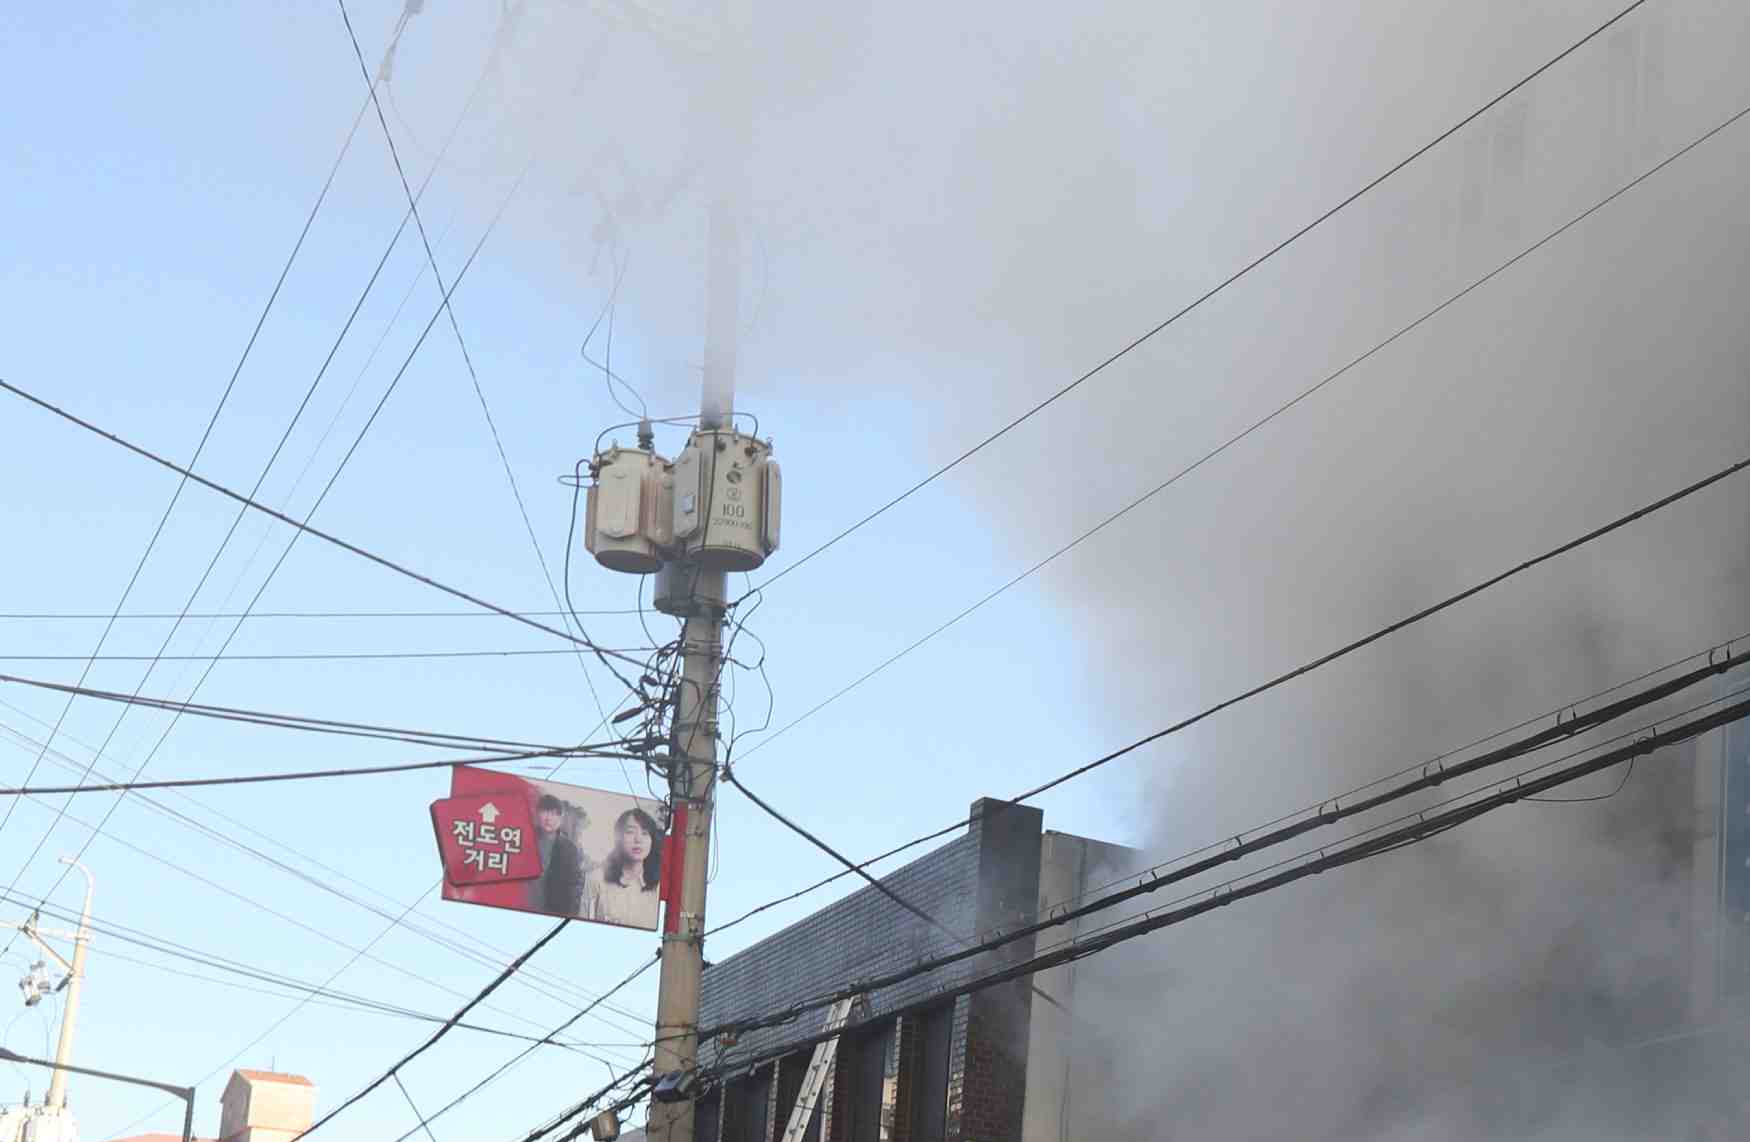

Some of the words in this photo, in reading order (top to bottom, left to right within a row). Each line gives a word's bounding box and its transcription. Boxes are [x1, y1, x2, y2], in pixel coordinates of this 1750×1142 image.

[722, 503, 745, 519] 100
[452, 819, 522, 853] 전도연
[463, 849, 510, 876] 거리
